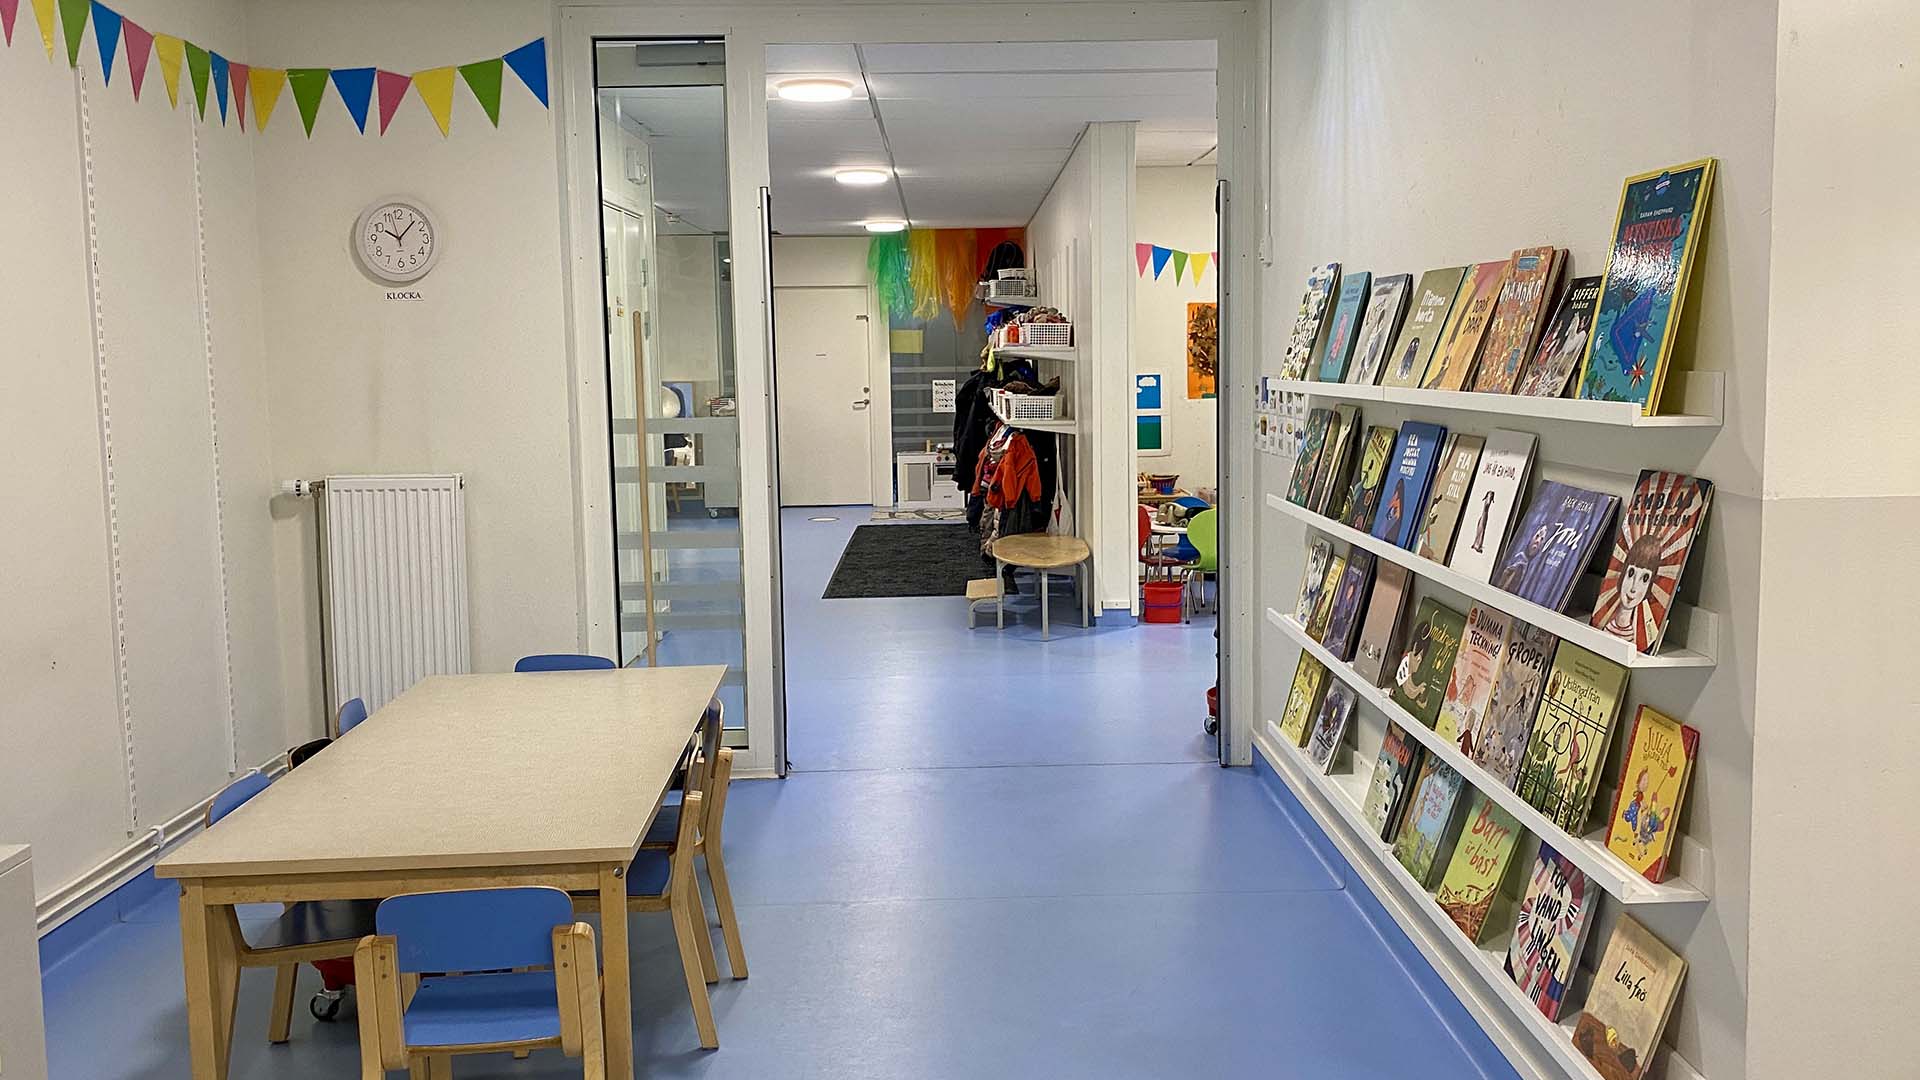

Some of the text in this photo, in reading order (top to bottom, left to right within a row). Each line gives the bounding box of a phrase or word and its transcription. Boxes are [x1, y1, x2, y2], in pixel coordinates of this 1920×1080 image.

[384, 212, 391, 222] 11
[393, 208, 403, 220] 12
[409, 212, 413, 222] 1
[375, 222, 384, 233] 10
[418, 221, 425, 232] 2
[370, 234, 378, 244] 9
[422, 233, 430, 245] 3
[376, 246, 382, 257] 8
[418, 246, 425, 256] 4
[385, 255, 391, 264] 7
[397, 257, 405, 268] 6
[409, 255, 417, 264] 5
[386, 292, 422, 300] KLOCKA
[1571, 287, 1600, 301] SIFFER
[1476, 610, 1503, 640] DUMMA
[1508, 641, 1547, 675] GROPEN
[1587, 686, 1601, 706] från
[1541, 712, 1589, 765] ZOO
[1472, 799, 1510, 849] Barr
[1464, 840, 1475, 855] är
[1469, 843, 1499, 878] bäst
[1535, 892, 1562, 922] VAND
[1614, 961, 1633, 990] Lilla
